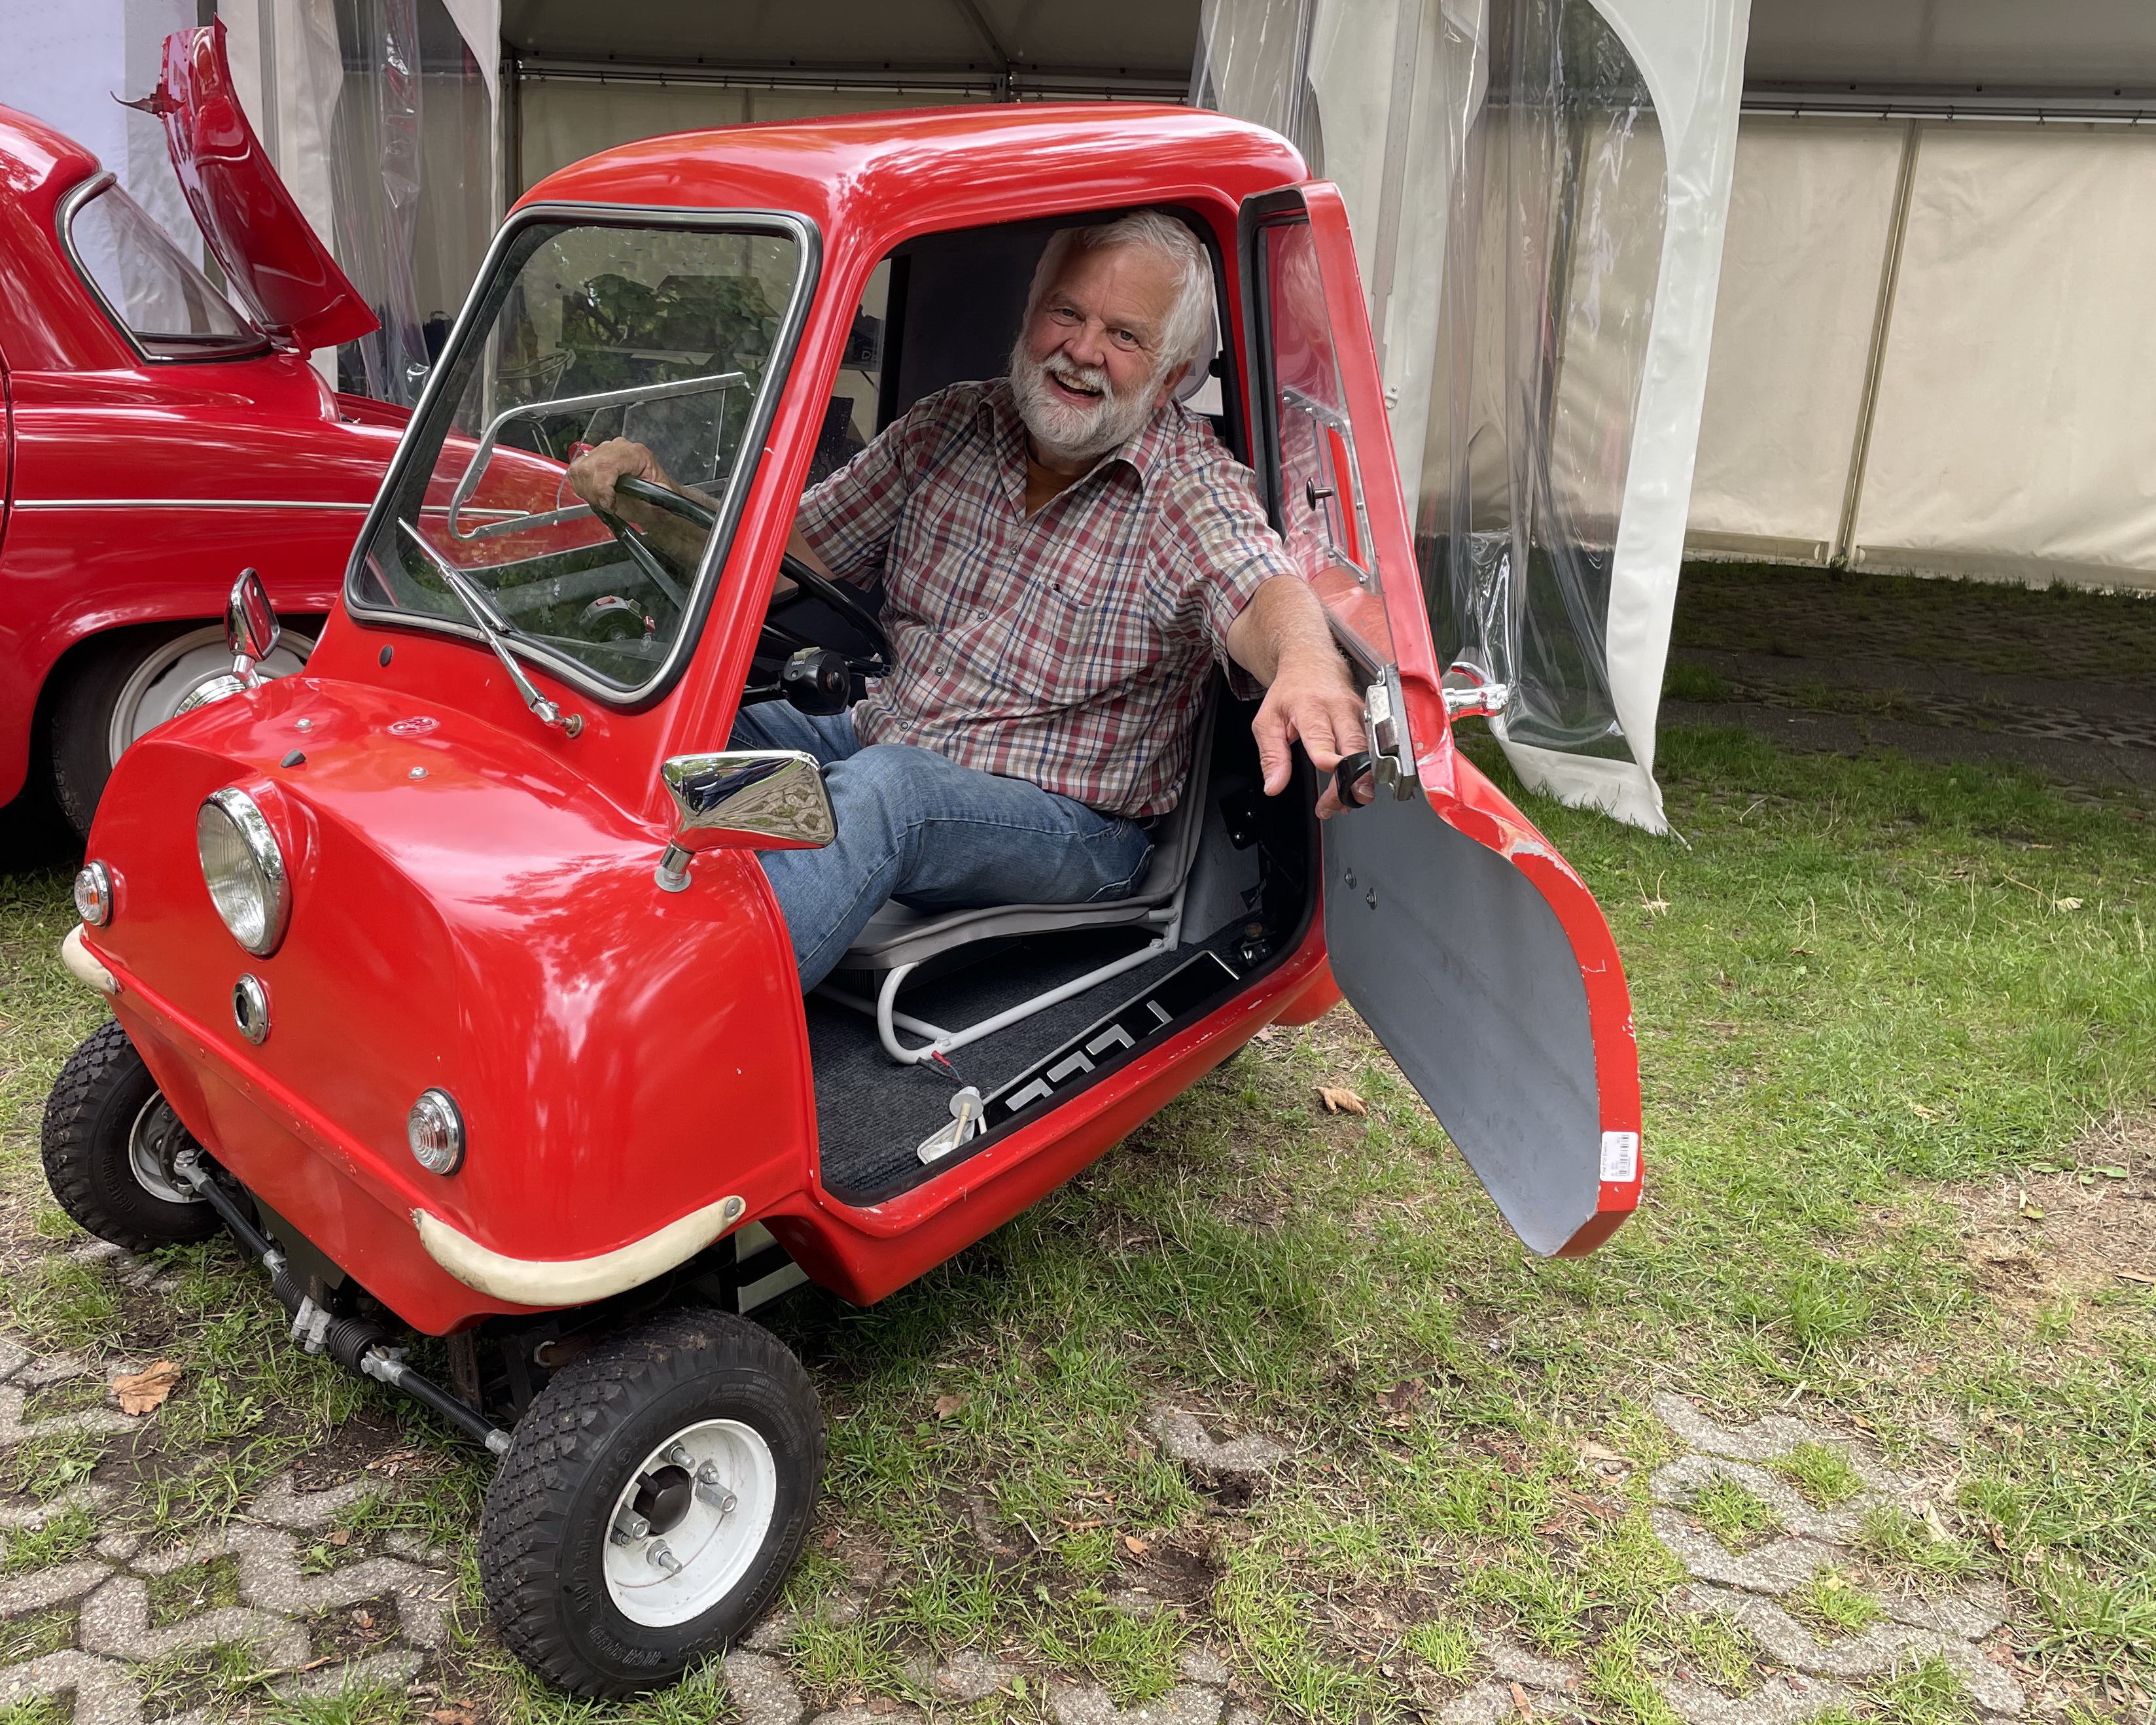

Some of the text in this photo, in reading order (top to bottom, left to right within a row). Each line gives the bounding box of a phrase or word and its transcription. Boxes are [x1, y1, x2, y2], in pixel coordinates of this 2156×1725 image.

[745, 1510, 801, 1609] TRELLEBORG
[588, 1625, 662, 1667] HIGH SPEED
